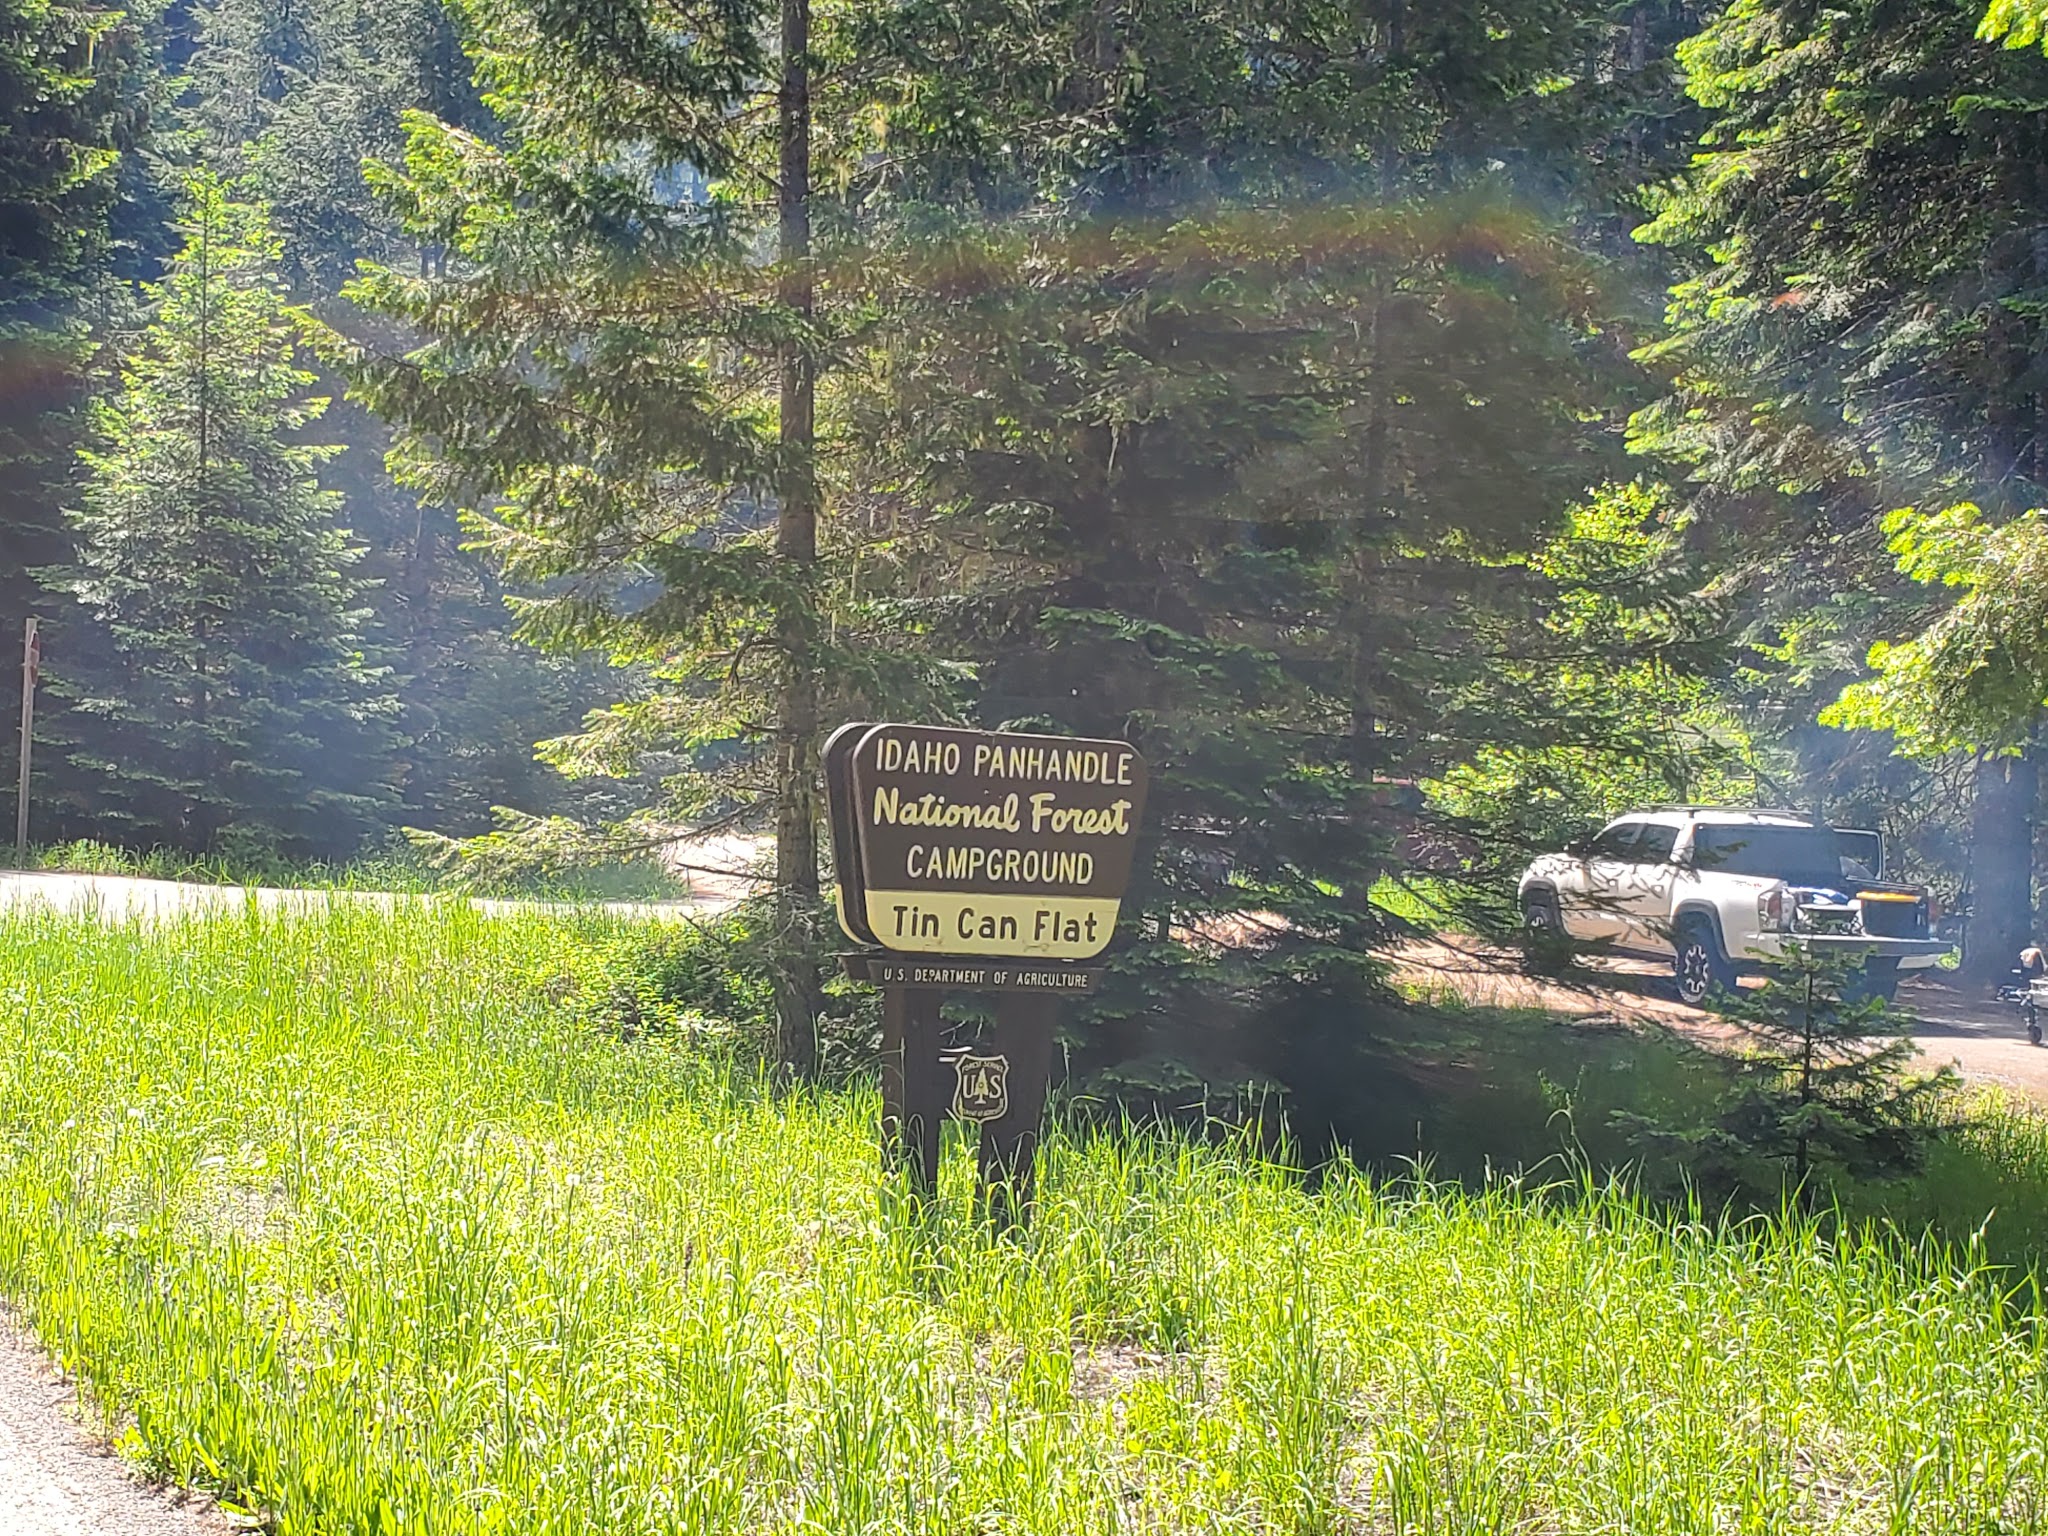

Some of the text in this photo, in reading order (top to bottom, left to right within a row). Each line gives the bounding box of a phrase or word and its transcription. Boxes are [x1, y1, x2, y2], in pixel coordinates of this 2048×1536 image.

[876, 738, 1133, 785] IDAHO PANHANDLE
[873, 786, 1132, 835] National Forest
[907, 844, 1093, 885] CAMPGROUND
[893, 905, 1098, 942] Tin Can Flat
[884, 968, 1088, 987] U.S. DEPARTMENT OF AGRICULTURE
